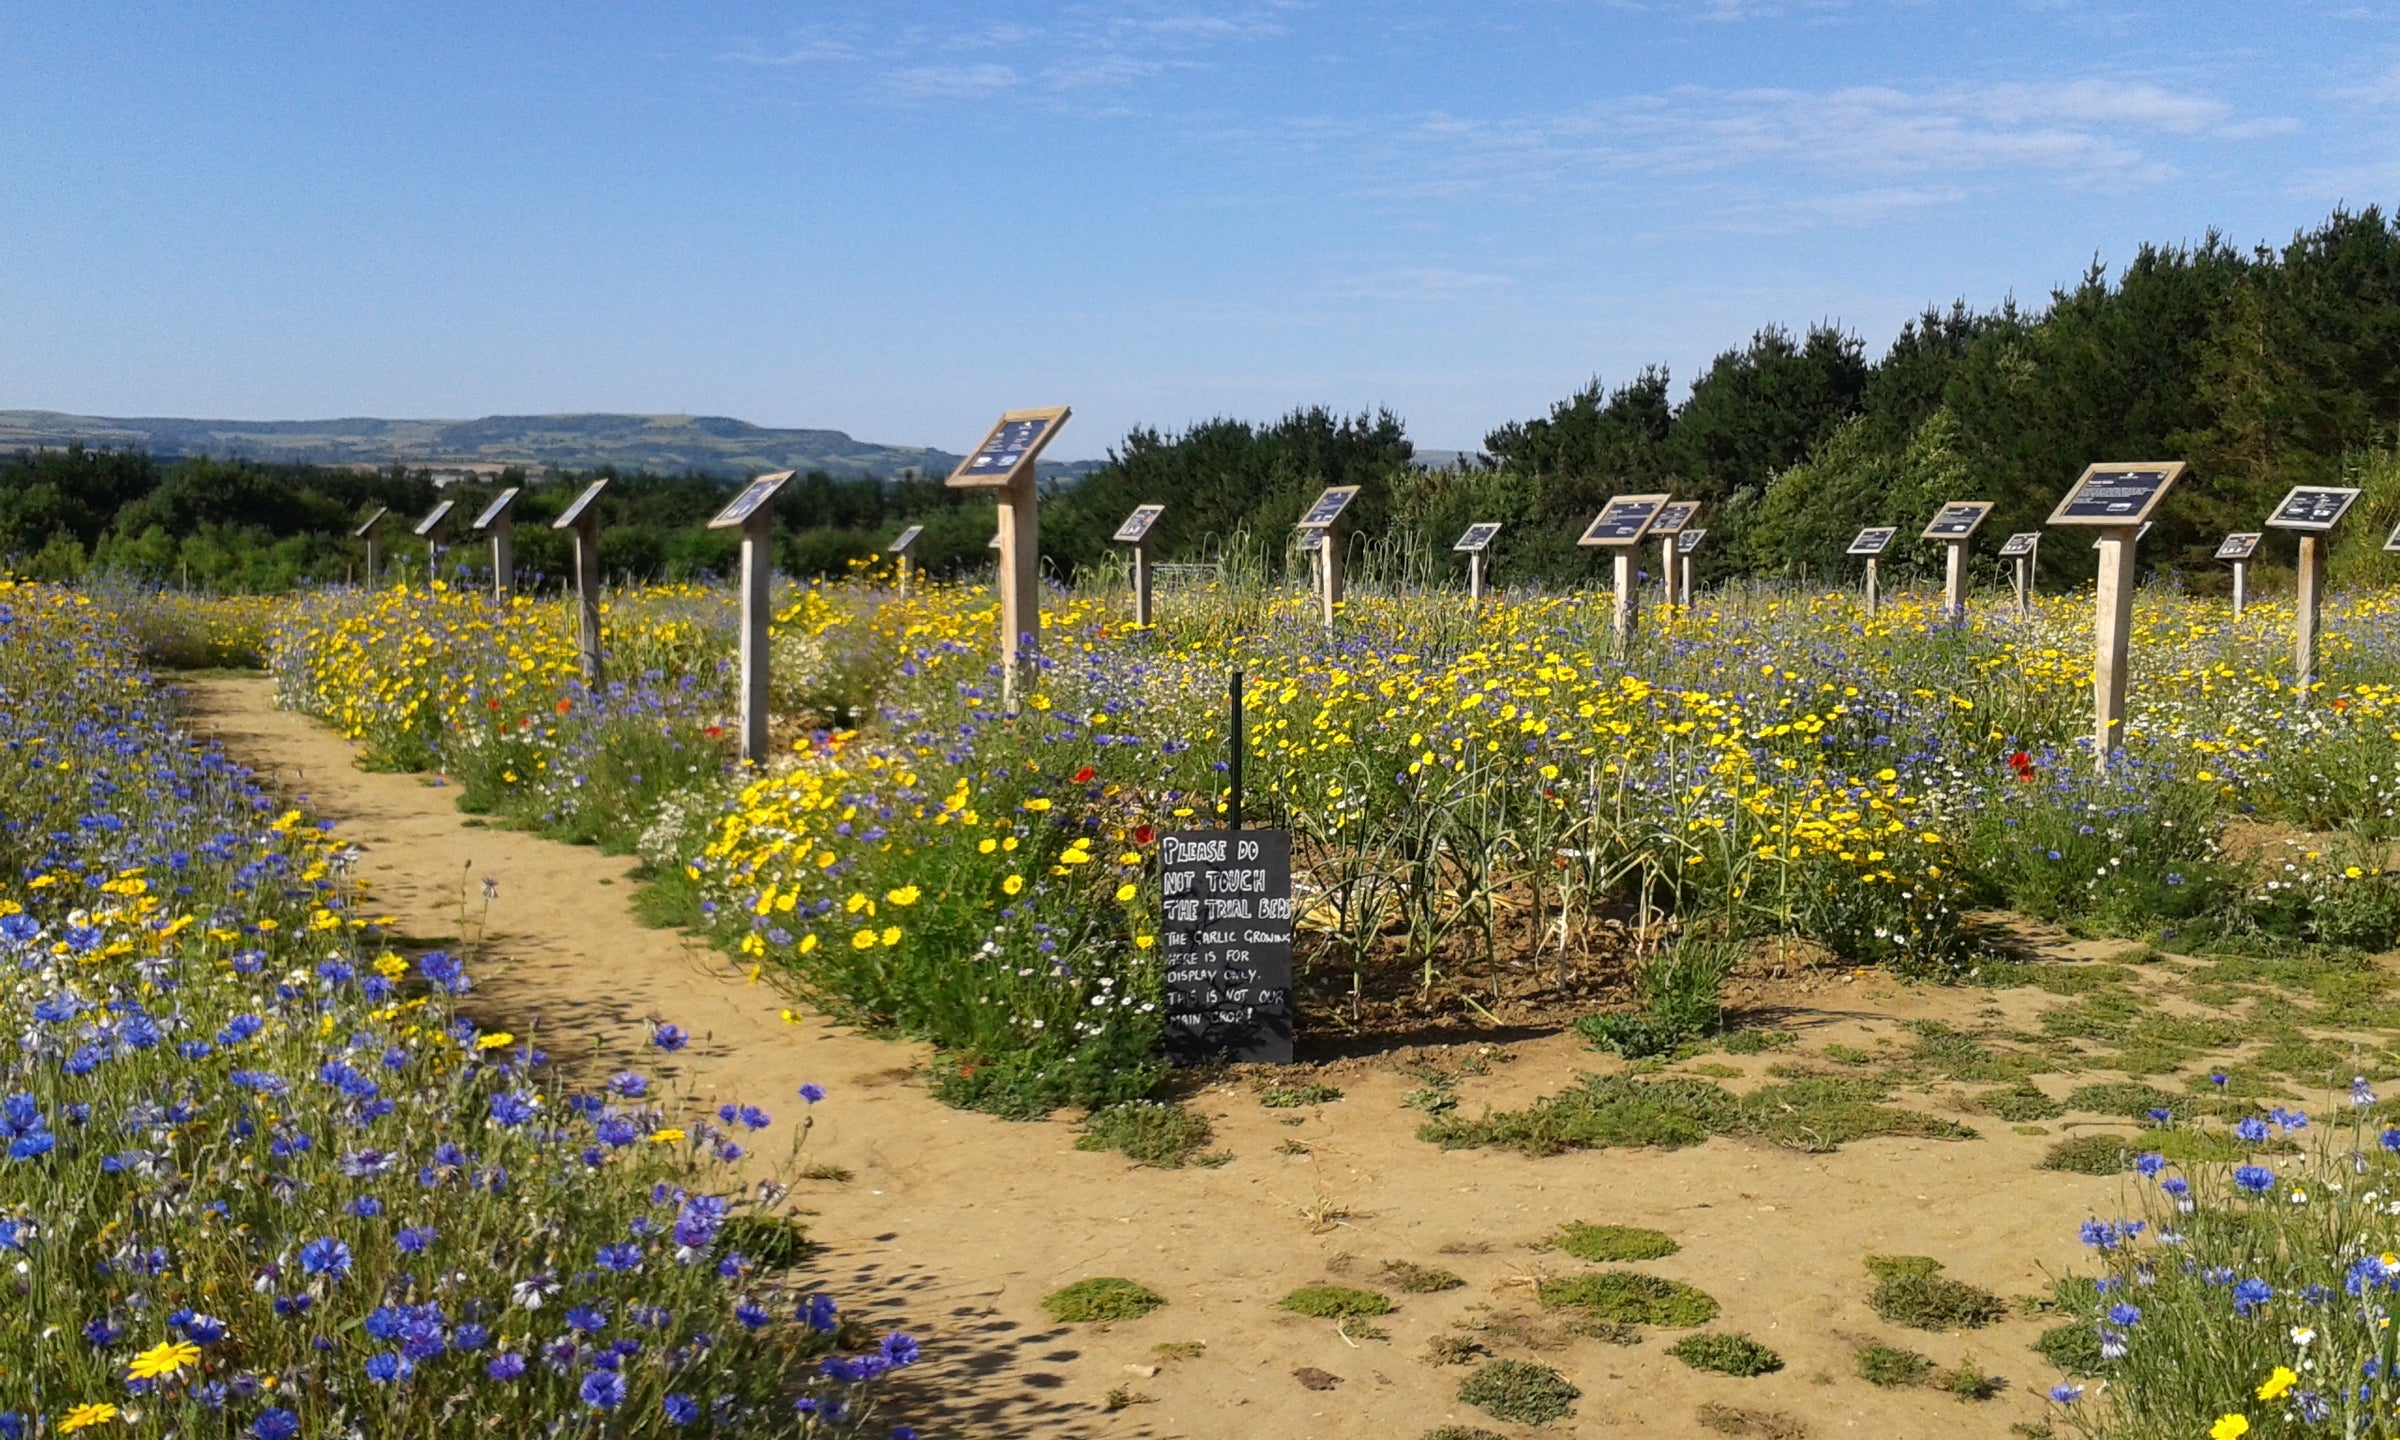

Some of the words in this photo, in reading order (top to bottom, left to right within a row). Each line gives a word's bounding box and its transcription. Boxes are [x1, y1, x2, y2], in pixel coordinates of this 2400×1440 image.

[1163, 837, 1227, 864] PLEASE
[1238, 840, 1259, 860] DO
[1164, 871, 1195, 895] NOT
[1206, 869, 1265, 892] TOUCH
[1163, 900, 1199, 921] THE
[1204, 899, 1251, 920] TRIAL
[1166, 932, 1187, 946] THE
[1194, 931, 1236, 945] GARLIC
[1168, 952, 1198, 965] HERE
[1205, 952, 1216, 962] IS
[1226, 950, 1249, 962] FOR
[1168, 970, 1217, 983] DISPLAY
[1224, 970, 1261, 983] ONLY.
[1168, 990, 1197, 1005] THIS
[1206, 988, 1217, 1003] IS
[1226, 989, 1248, 1001] NOT
[1259, 990, 1284, 1004] OUR
[1170, 1014, 1201, 1025] MAIN
